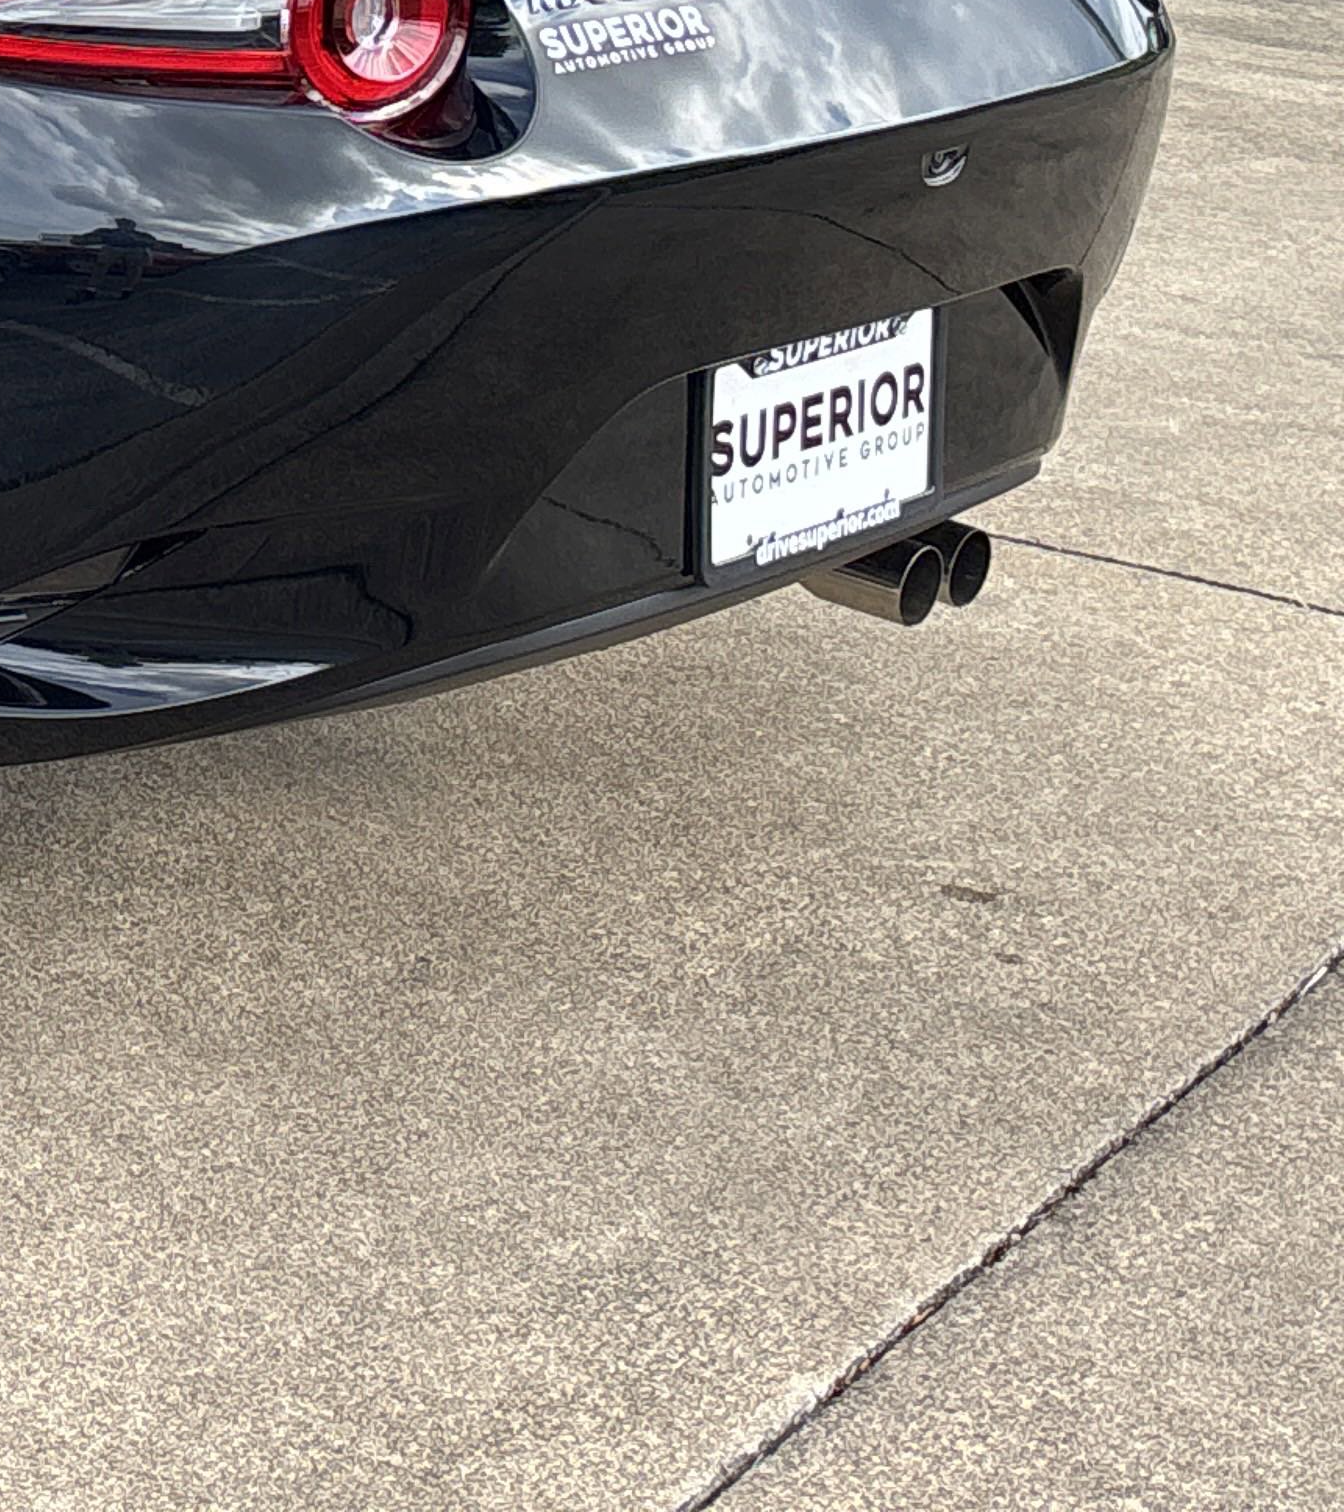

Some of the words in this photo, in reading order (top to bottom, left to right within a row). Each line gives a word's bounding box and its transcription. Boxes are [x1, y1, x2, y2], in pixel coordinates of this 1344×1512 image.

[539, 5, 711, 60] SUPERIOR
[554, 45, 659, 75] AUTOMOTIVE
[663, 35, 717, 56] GROUP
[768, 317, 890, 372] SUPERIOR
[711, 362, 926, 477] SUPERIOR
[860, 422, 925, 461] GROUP
[755, 499, 901, 566] drivesuperior.com
